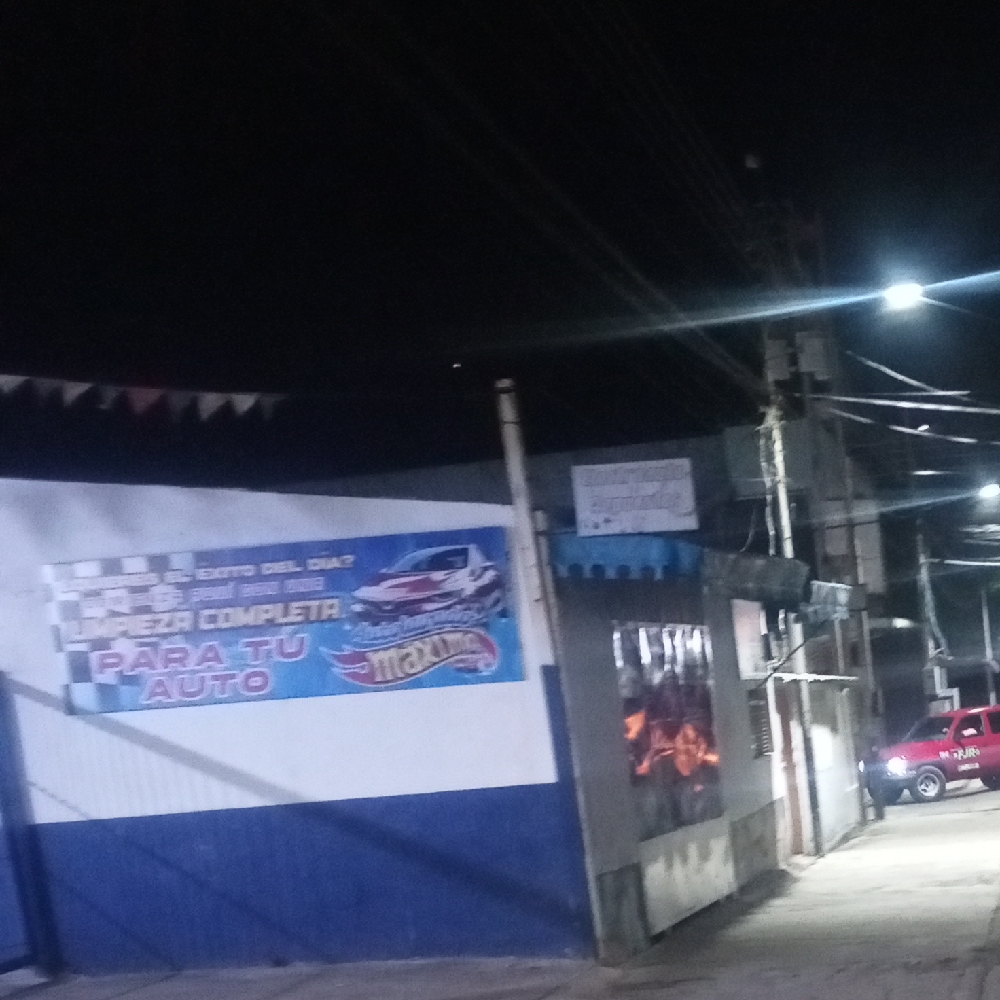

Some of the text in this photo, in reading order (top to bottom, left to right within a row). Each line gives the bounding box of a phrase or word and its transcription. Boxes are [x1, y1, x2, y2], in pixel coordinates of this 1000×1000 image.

[198, 598, 341, 631] COMPLETA
[91, 641, 227, 675] PARA
[140, 667, 271, 704] AUTO
